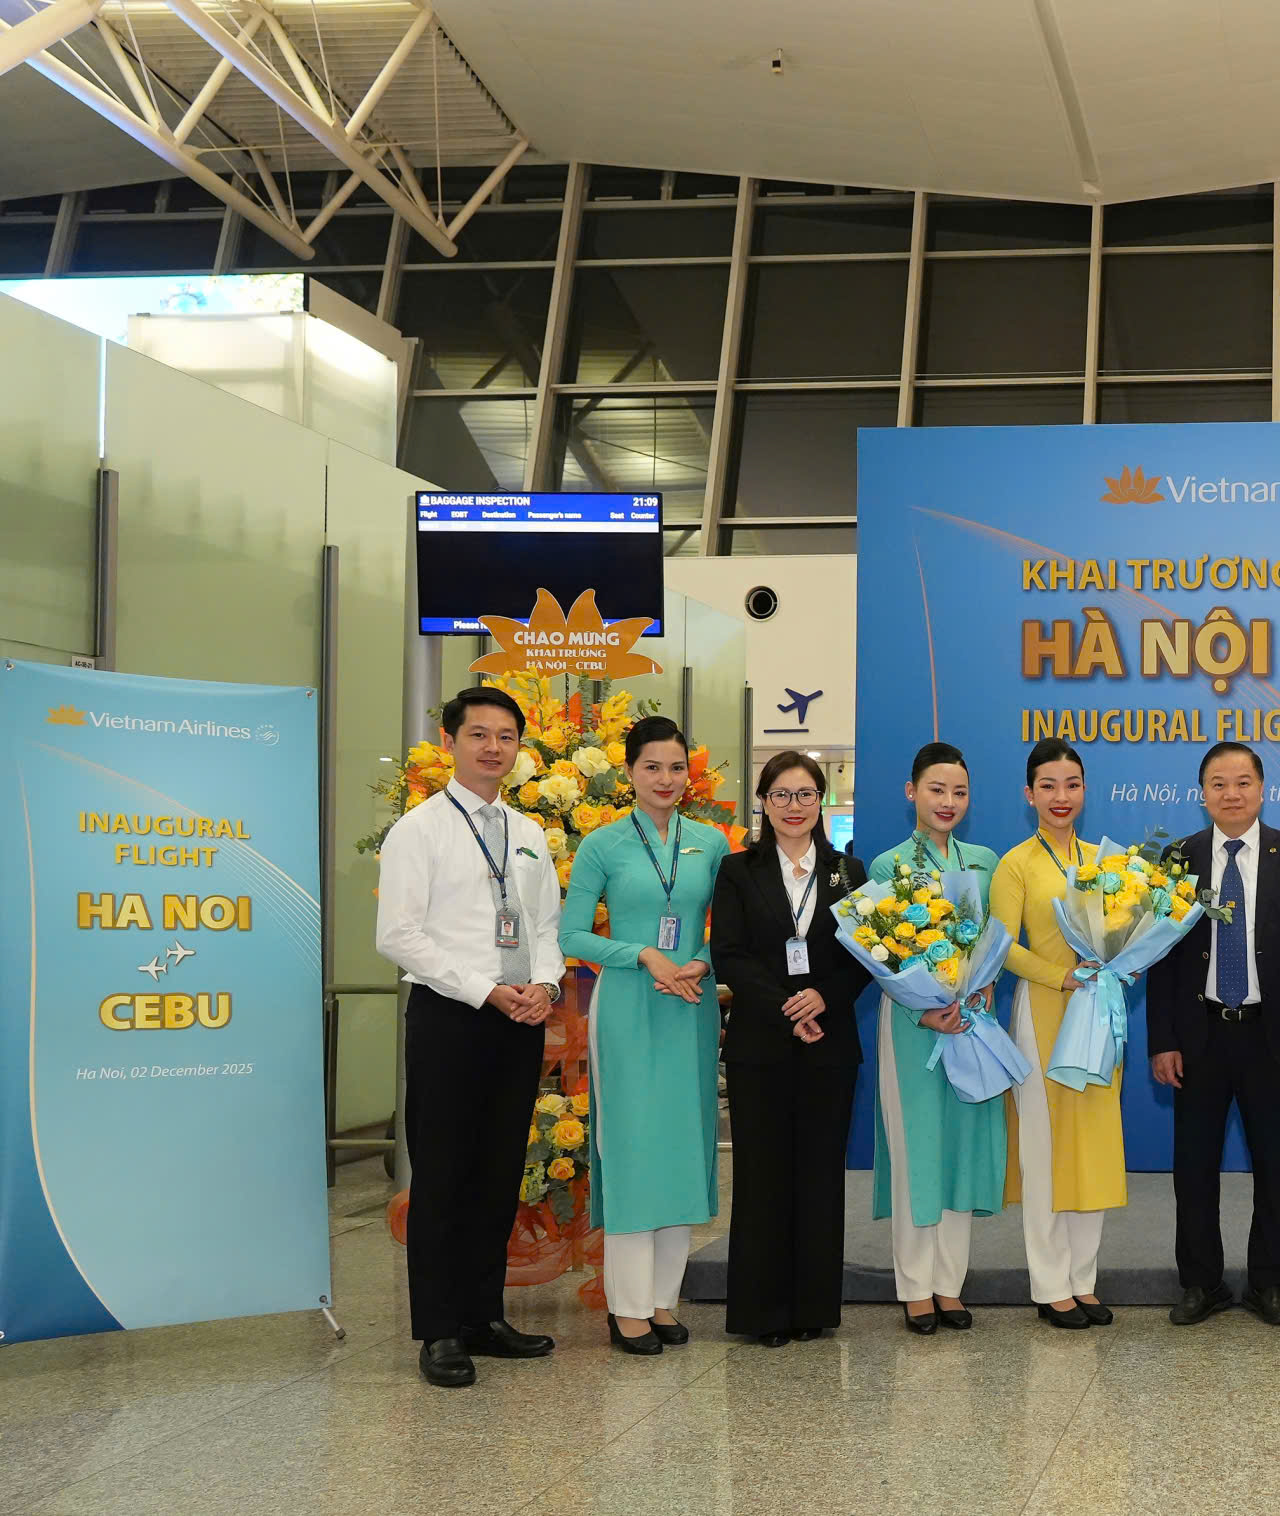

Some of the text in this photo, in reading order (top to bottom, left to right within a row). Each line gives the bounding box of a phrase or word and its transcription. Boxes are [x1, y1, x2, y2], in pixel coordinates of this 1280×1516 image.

[431, 496, 530, 506] BAGGAGE INSPECTION
[632, 497, 658, 507] 21:09
[1022, 559, 1116, 590] KHAI
[453, 620, 479, 629] Please
[526, 648, 606, 658] KHAI TRƯƠNG
[1022, 607, 1126, 678] HÀ
[1141, 606, 1270, 694] NỘI
[545, 660, 567, 670] NỘI
[575, 661, 607, 670] CEBU
[89, 711, 177, 733] Vietnam
[178, 719, 251, 740] Airlines
[1022, 709, 1208, 742] INAUGURAL
[1111, 783, 1138, 801] Hà
[1143, 783, 1181, 806] Nội,
[79, 811, 250, 839] INAUGURAL
[115, 843, 218, 867] FLIGHT
[77, 892, 252, 931] HA NOI
[98, 992, 232, 1031] CEBU
[76, 1063, 253, 1080] Ha Noi, 02 December 2025
